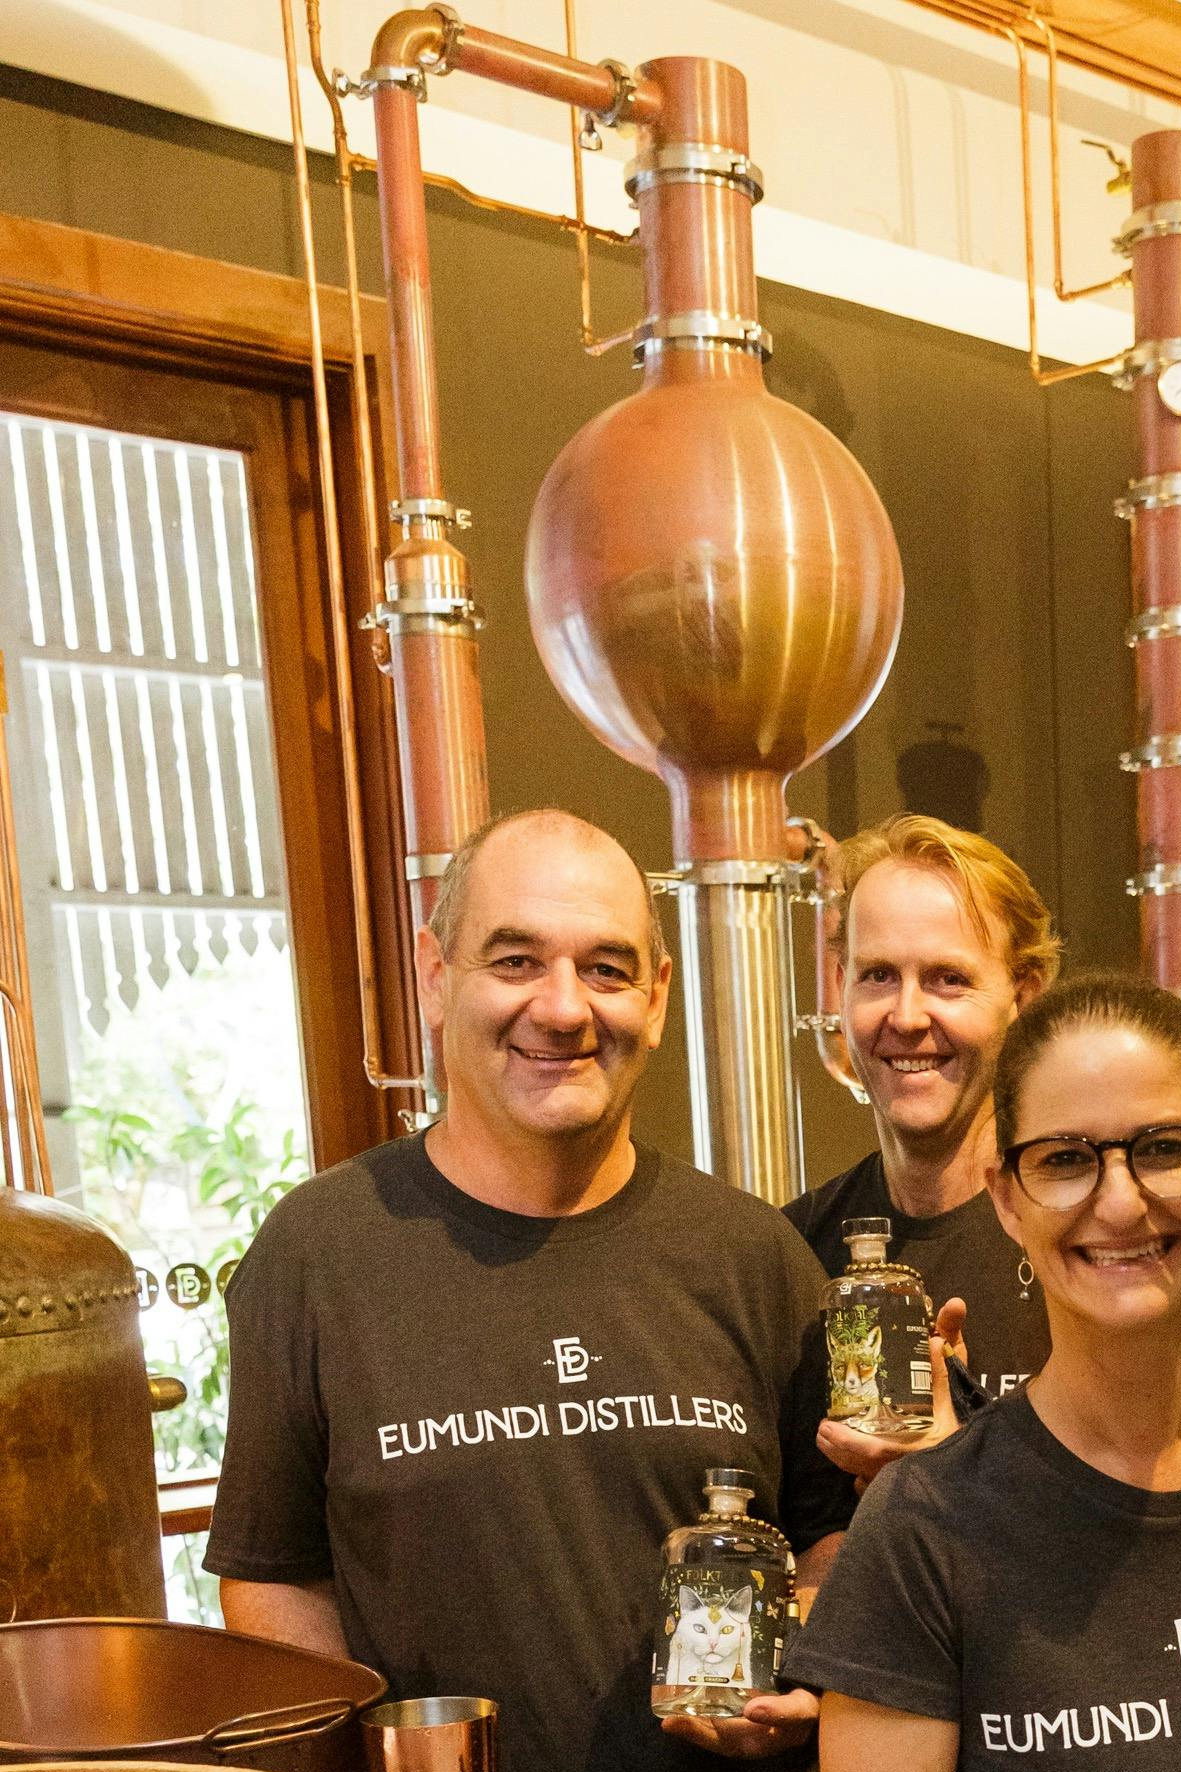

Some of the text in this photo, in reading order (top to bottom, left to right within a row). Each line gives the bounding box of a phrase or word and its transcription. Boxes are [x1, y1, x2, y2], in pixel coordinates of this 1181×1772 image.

[377, 1394, 748, 1460] EUMUNDI DISTILLERS
[980, 1698, 1173, 1753] EUMUNDI
